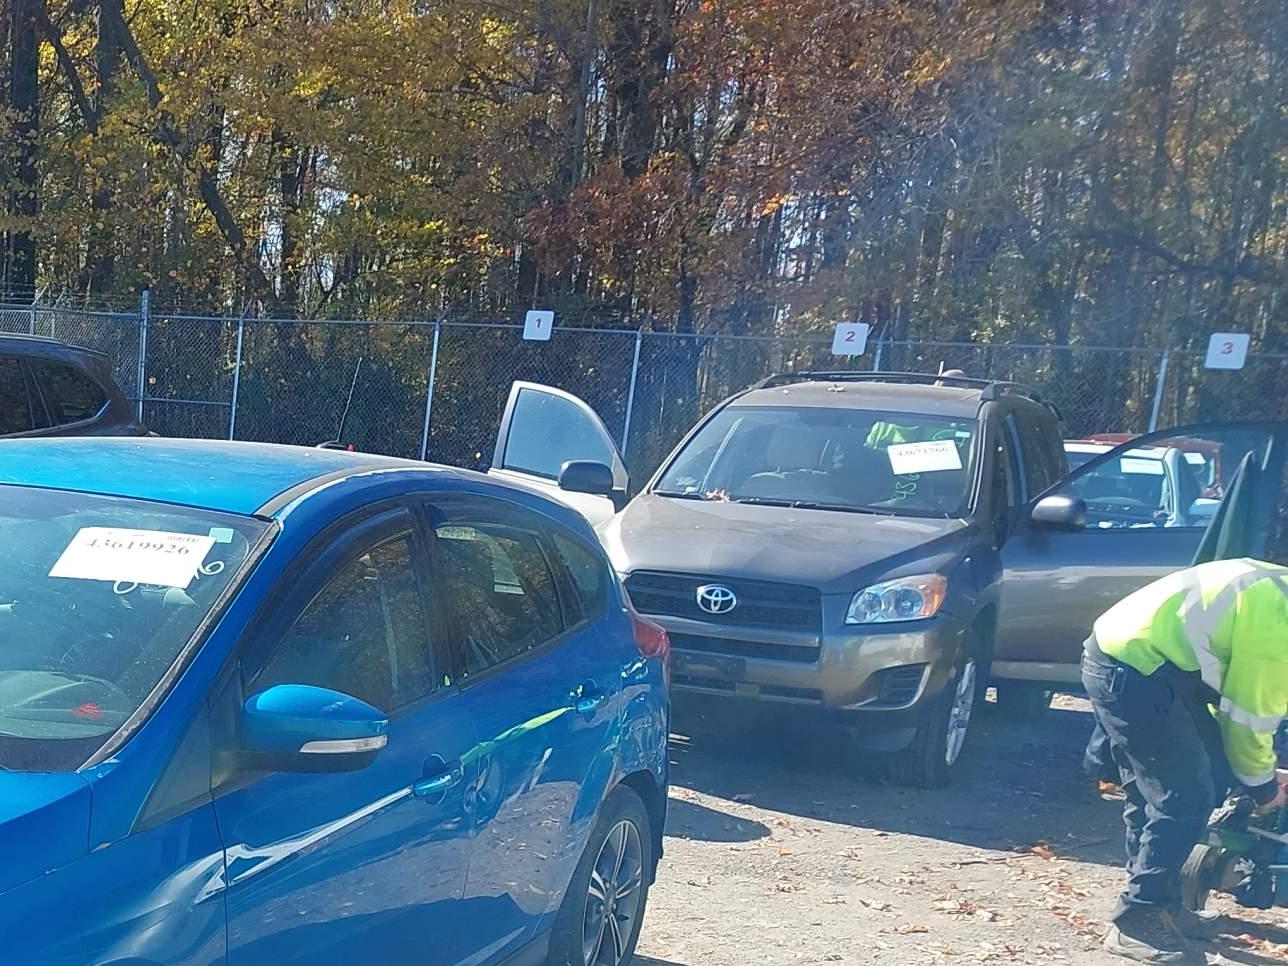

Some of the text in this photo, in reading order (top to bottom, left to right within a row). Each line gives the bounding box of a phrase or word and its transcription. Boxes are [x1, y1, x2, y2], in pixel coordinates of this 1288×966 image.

[535, 318, 542, 329] 1
[845, 331, 856, 342] 2
[1221, 342, 1234, 354] 3
